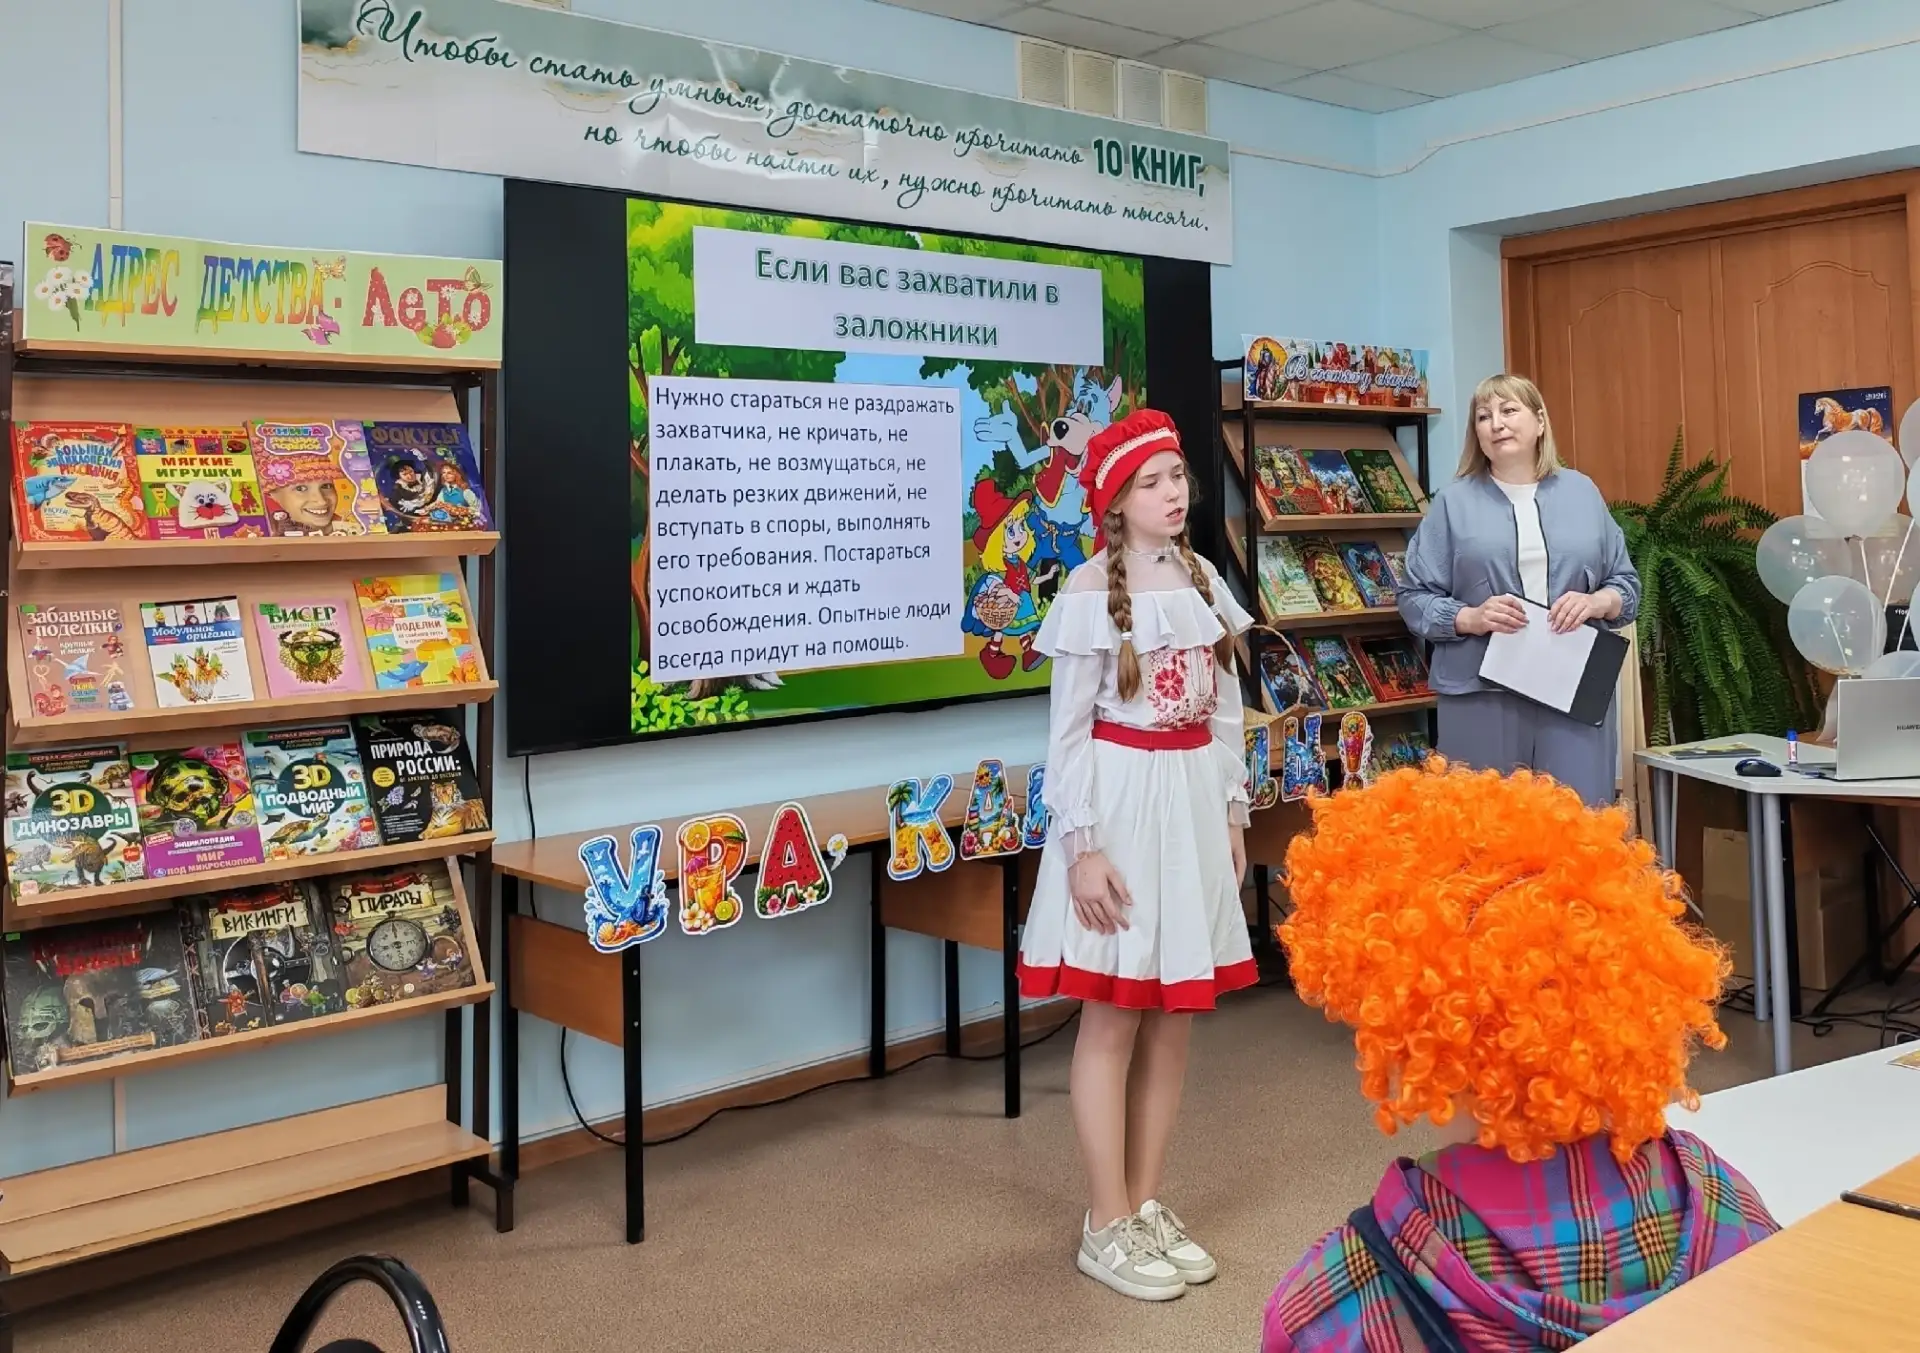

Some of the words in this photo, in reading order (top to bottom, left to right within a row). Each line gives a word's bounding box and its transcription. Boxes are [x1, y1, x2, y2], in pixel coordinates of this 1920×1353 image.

[356, 0, 518, 68] Чтобы
[530, 55, 640, 88] стать
[628, 76, 773, 118] умным,
[766, 99, 948, 141] достаточно
[954, 126, 1085, 165] прочитать
[1093, 139, 1123, 177] 10
[1132, 145, 1205, 197] КНИГ,
[584, 124, 623, 144] но
[633, 129, 738, 163] чтобы
[746, 149, 839, 178] найти
[849, 163, 890, 189] их,
[897, 171, 985, 209] нужно
[990, 182, 1117, 217] прочитать
[1122, 204, 1209, 232] тысячи.
[84, 243, 180, 327] АДРЕС
[754, 247, 829, 285] Если
[839, 265, 889, 291] вас
[896, 270, 1038, 303] захватили
[1045, 285, 1060, 304] в
[834, 313, 998, 348] заложники
[656, 386, 724, 411] Нужно
[730, 392, 822, 413] стараться
[828, 396, 849, 411] не
[855, 397, 954, 416] раздражать
[262, 427, 324, 436] КНИГА
[371, 426, 461, 445] ФОКУСЫ
[655, 423, 772, 442] захватчика,
[778, 426, 801, 441] не
[807, 427, 882, 445] кричать,
[888, 428, 908, 442] не
[46, 454, 122, 469] ЭНЦИКЛОПЕДИЯ
[55, 444, 114, 460] БОЛЬШАЯ
[161, 457, 233, 466] МЯГКИЕ
[156, 468, 242, 477] ИГРУШКИ
[656, 456, 742, 475] плакать,
[749, 457, 771, 471] не
[778, 456, 900, 475] возмущаться,
[906, 456, 926, 471] не
[655, 487, 727, 508] делать
[733, 486, 799, 508] резких
[804, 483, 902, 505] движений,
[907, 485, 927, 500] не
[657, 518, 744, 540] вступать
[751, 519, 760, 533] в
[767, 516, 832, 539] споры,
[837, 514, 930, 532] выполнять
[657, 553, 690, 571] его
[696, 548, 818, 572] требования.
[824, 543, 930, 566] Постараться
[657, 581, 781, 607] успокоиться
[788, 581, 799, 596] и
[805, 577, 861, 597] ждать
[28, 607, 117, 625] забавные
[395, 620, 442, 632] ПОДЕЛКИ
[657, 611, 812, 637] освобождения.
[818, 604, 901, 625] Опытные
[905, 601, 951, 619] люди
[35, 622, 114, 639] поделки
[152, 625, 215, 637] Модульное
[186, 630, 236, 641] оригами
[658, 648, 724, 671] всегда
[731, 643, 799, 664] придут
[805, 641, 826, 657] на
[832, 636, 909, 655] помощь.
[370, 740, 433, 760] ПРИРОДА
[291, 764, 331, 789] 3D
[396, 755, 461, 776] РОССИИ:
[50, 789, 94, 816] 3D
[265, 783, 361, 806] ПОДВОДНЫЙ
[300, 801, 335, 815] МИР
[17, 812, 130, 837] ДИНОЗАВРЫ
[174, 835, 235, 849] ЭНЦИКЛОПЕДИЯ
[167, 865, 186, 875] ПОД
[188, 856, 257, 872] МИКРОСКОПОМ
[196, 851, 225, 862] МИР
[358, 890, 422, 914] ПИРАТЫ
[222, 906, 297, 934] ВИКИНГИ
